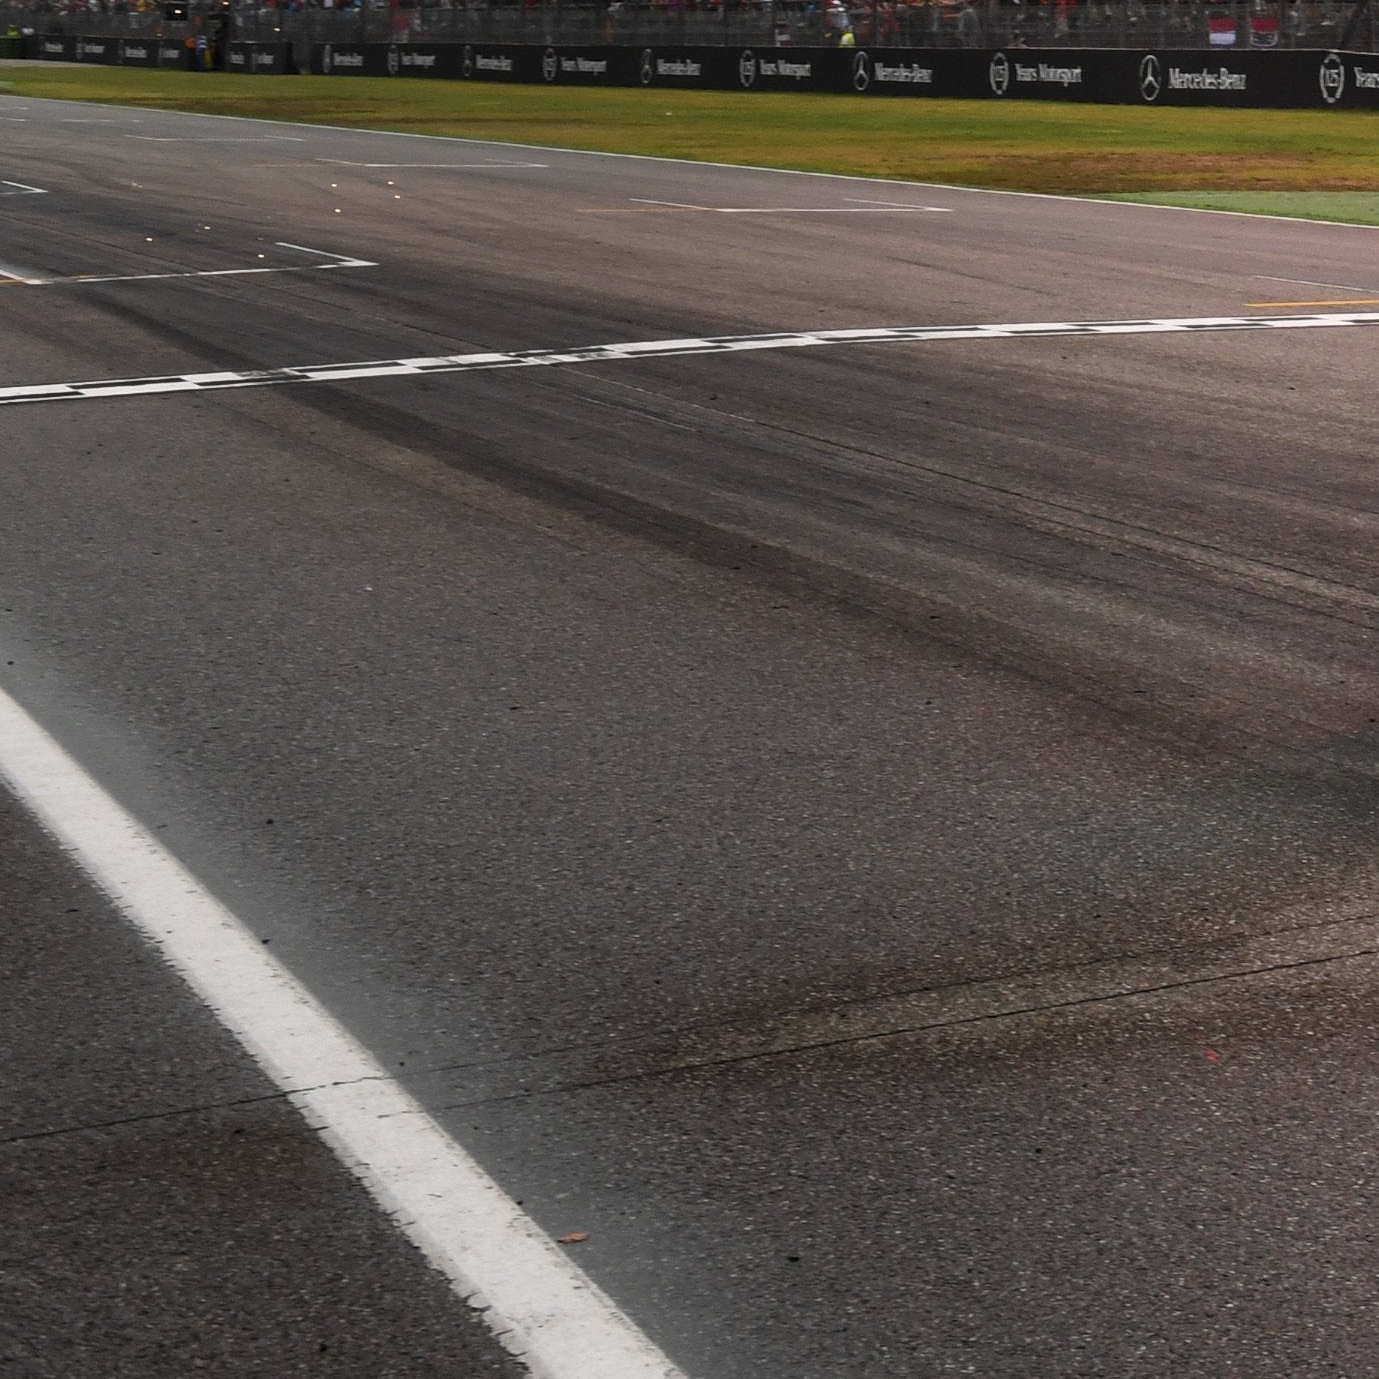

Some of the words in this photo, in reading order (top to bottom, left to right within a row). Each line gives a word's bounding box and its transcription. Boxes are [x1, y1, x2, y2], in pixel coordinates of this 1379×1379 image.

[874, 62, 933, 83] Mercedes-Benz
[1015, 64, 1037, 82] Years
[1038, 63, 1082, 87] Motorsport
[1168, 67, 1247, 91] Mercedes-Benz
